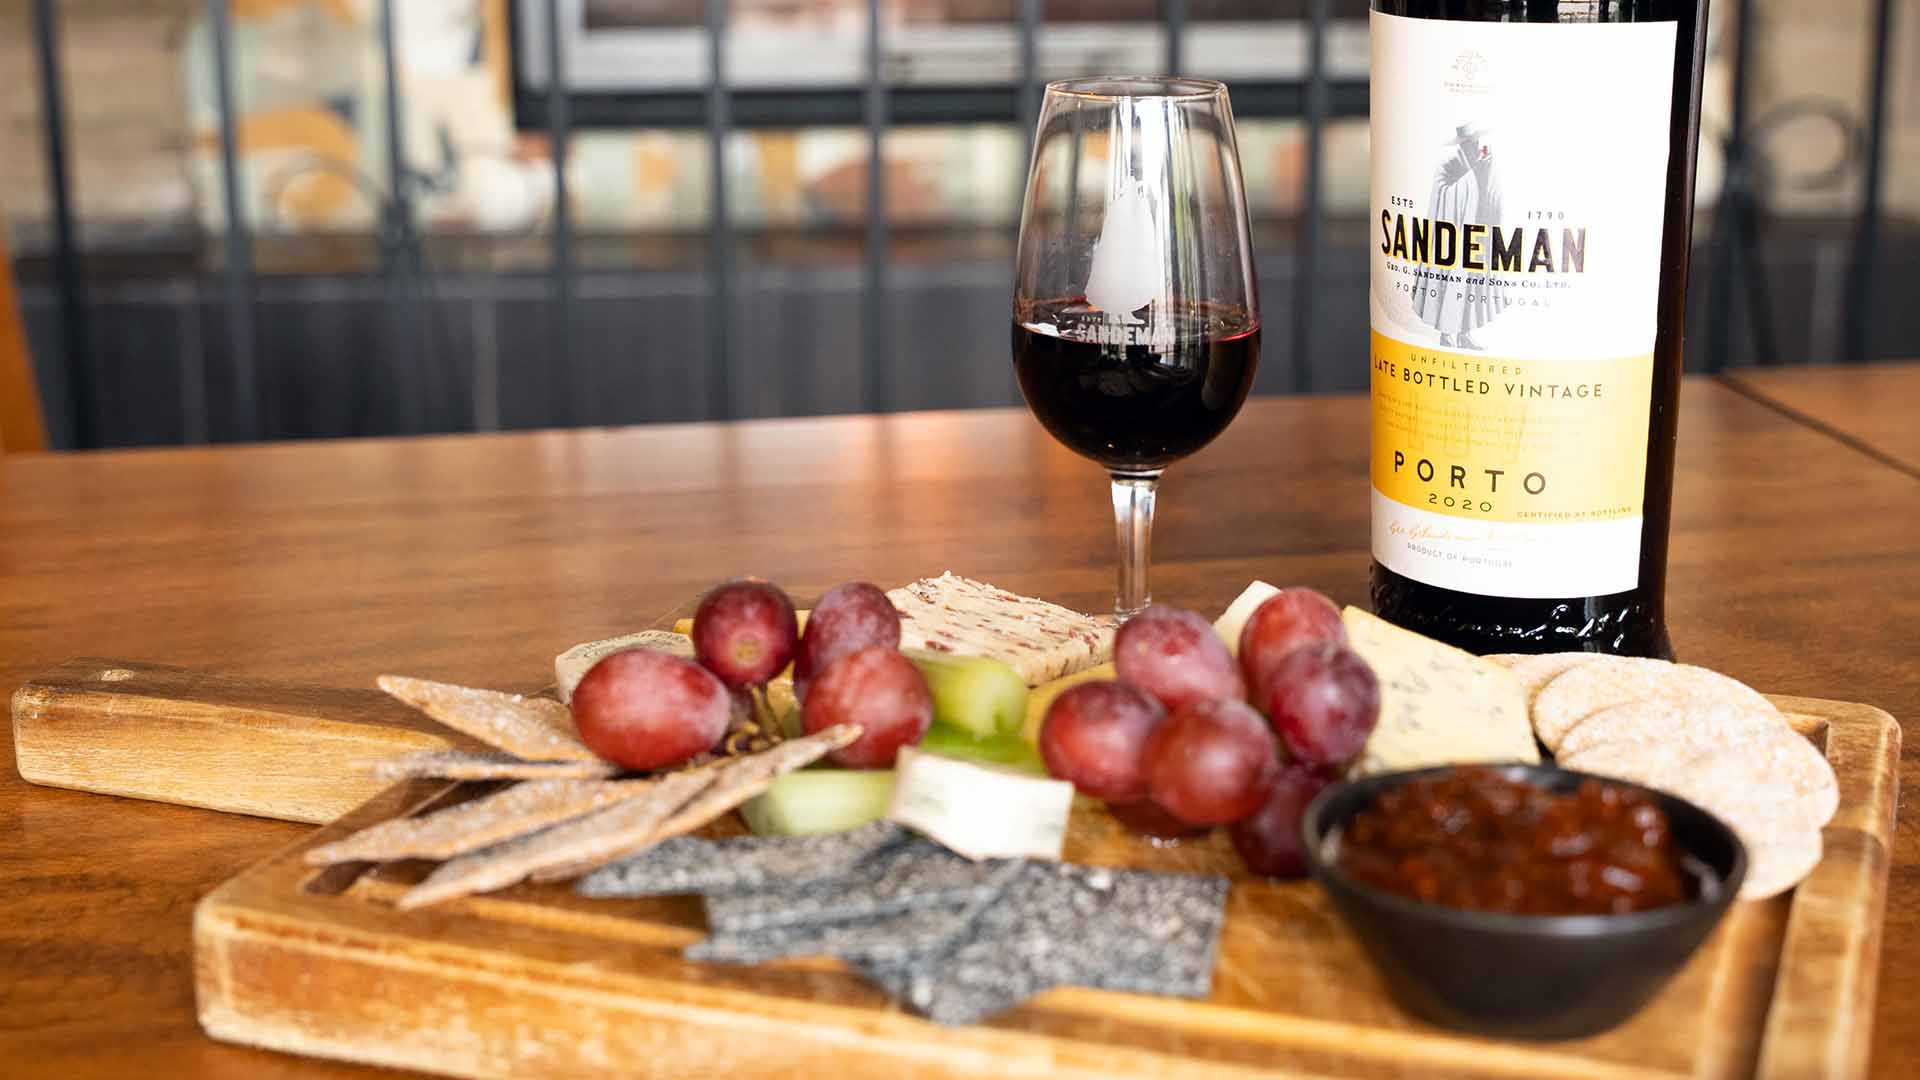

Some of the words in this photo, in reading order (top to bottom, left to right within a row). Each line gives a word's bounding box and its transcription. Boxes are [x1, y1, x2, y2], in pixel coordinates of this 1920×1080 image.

[1527, 210, 1565, 221] 1790
[1381, 208, 1588, 274] SANDEMAN
[1413, 268, 1462, 283] SANDEMAN
[1465, 276, 1485, 286] and
[1396, 281, 1437, 298] PORTO
[1456, 292, 1551, 307] PORTUGAL
[1076, 322, 1176, 346] SANDEMAN
[1410, 353, 1522, 375] UNFILTERED
[1374, 355, 1396, 377] LATE
[1403, 367, 1490, 395] BOTTLED
[1504, 383, 1603, 398] VINTAGE
[1394, 450, 1546, 495] PORTO
[1428, 493, 1492, 512] 2020
[1407, 541, 1443, 558] PRODUCT
